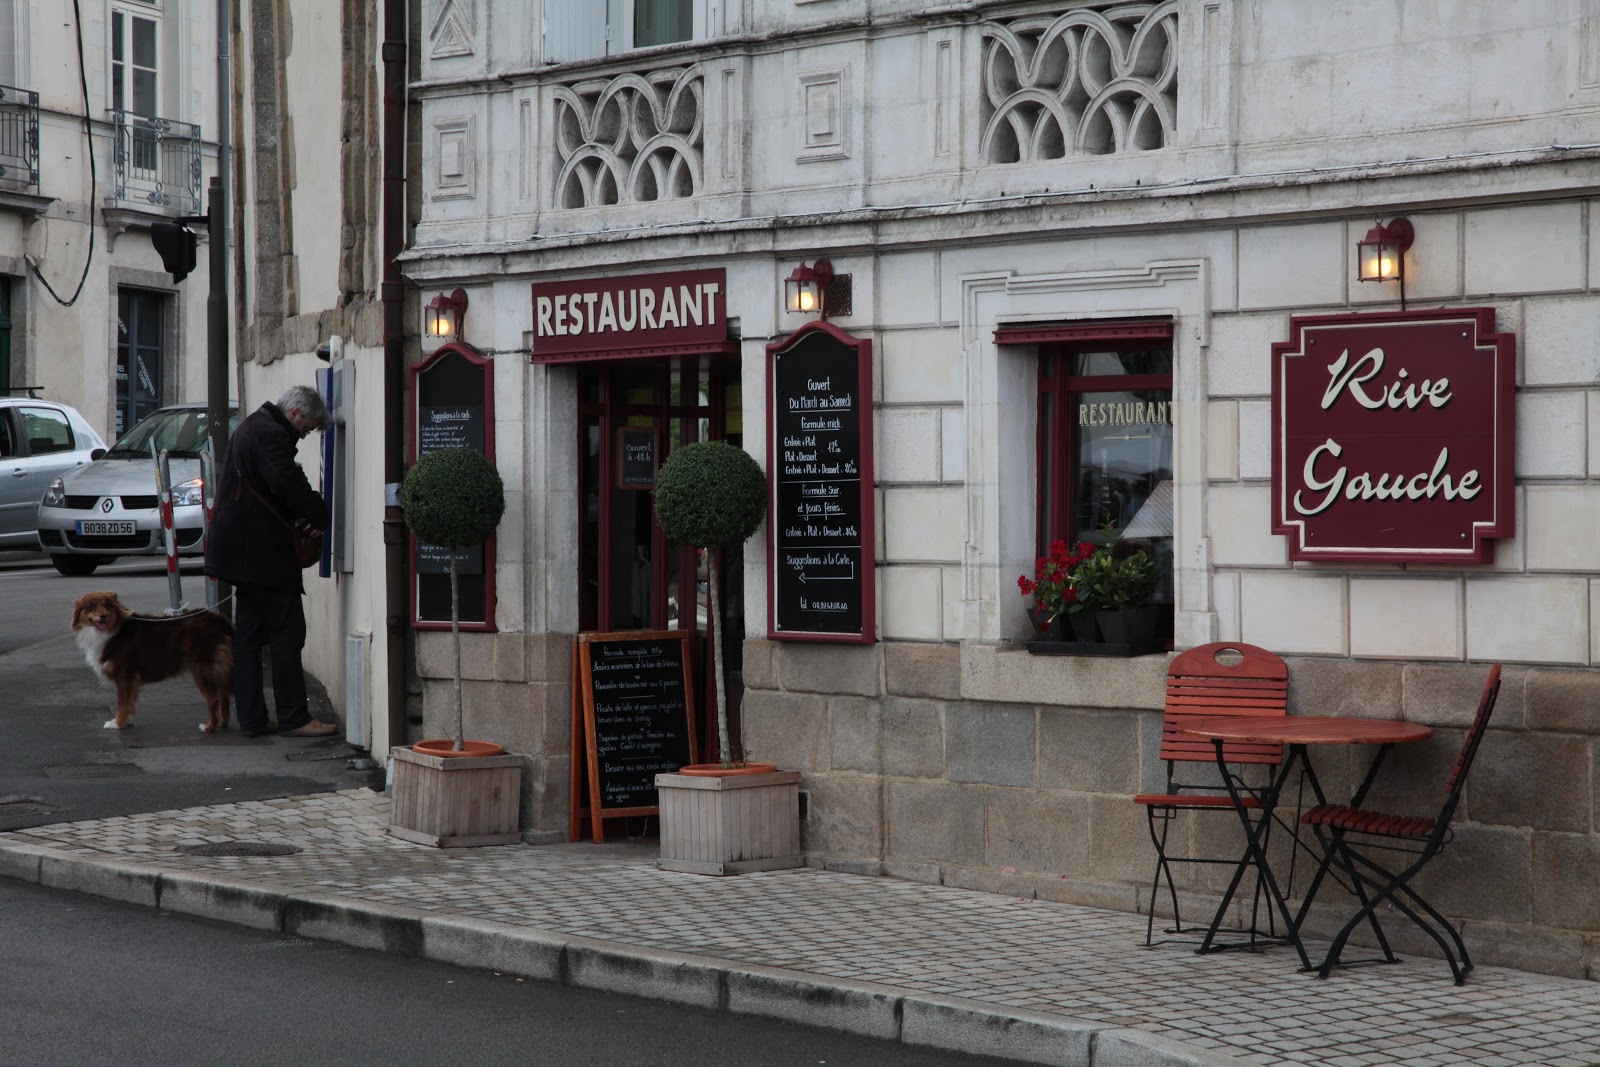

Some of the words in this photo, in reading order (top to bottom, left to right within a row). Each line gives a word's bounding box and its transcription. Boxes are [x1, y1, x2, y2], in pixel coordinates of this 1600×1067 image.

[536, 282, 719, 337] RESTAURANT
[1321, 347, 1453, 410] Rive
[789, 397, 799, 409] Du
[800, 395, 818, 409] Mardi
[819, 398, 828, 408] au
[829, 393, 852, 408] Samedi
[801, 416, 826, 429] Formule
[626, 441, 652, 452] Ouvert
[804, 434, 817, 447] Plat
[784, 450, 796, 462] Plat
[798, 449, 818, 462] Dessert
[806, 463, 817, 474] Plat
[821, 462, 840, 474] Dessert
[1294, 438, 1482, 516] Gauche
[801, 483, 827, 496] Formule
[83, 522, 107, 534] 8038
[107, 522, 119, 534] ZD
[120, 522, 133, 534] 56
[807, 524, 818, 537] Plat
[822, 525, 842, 537] Dessert
[786, 553, 821, 570] Suggestions
[827, 552, 835, 565] la
